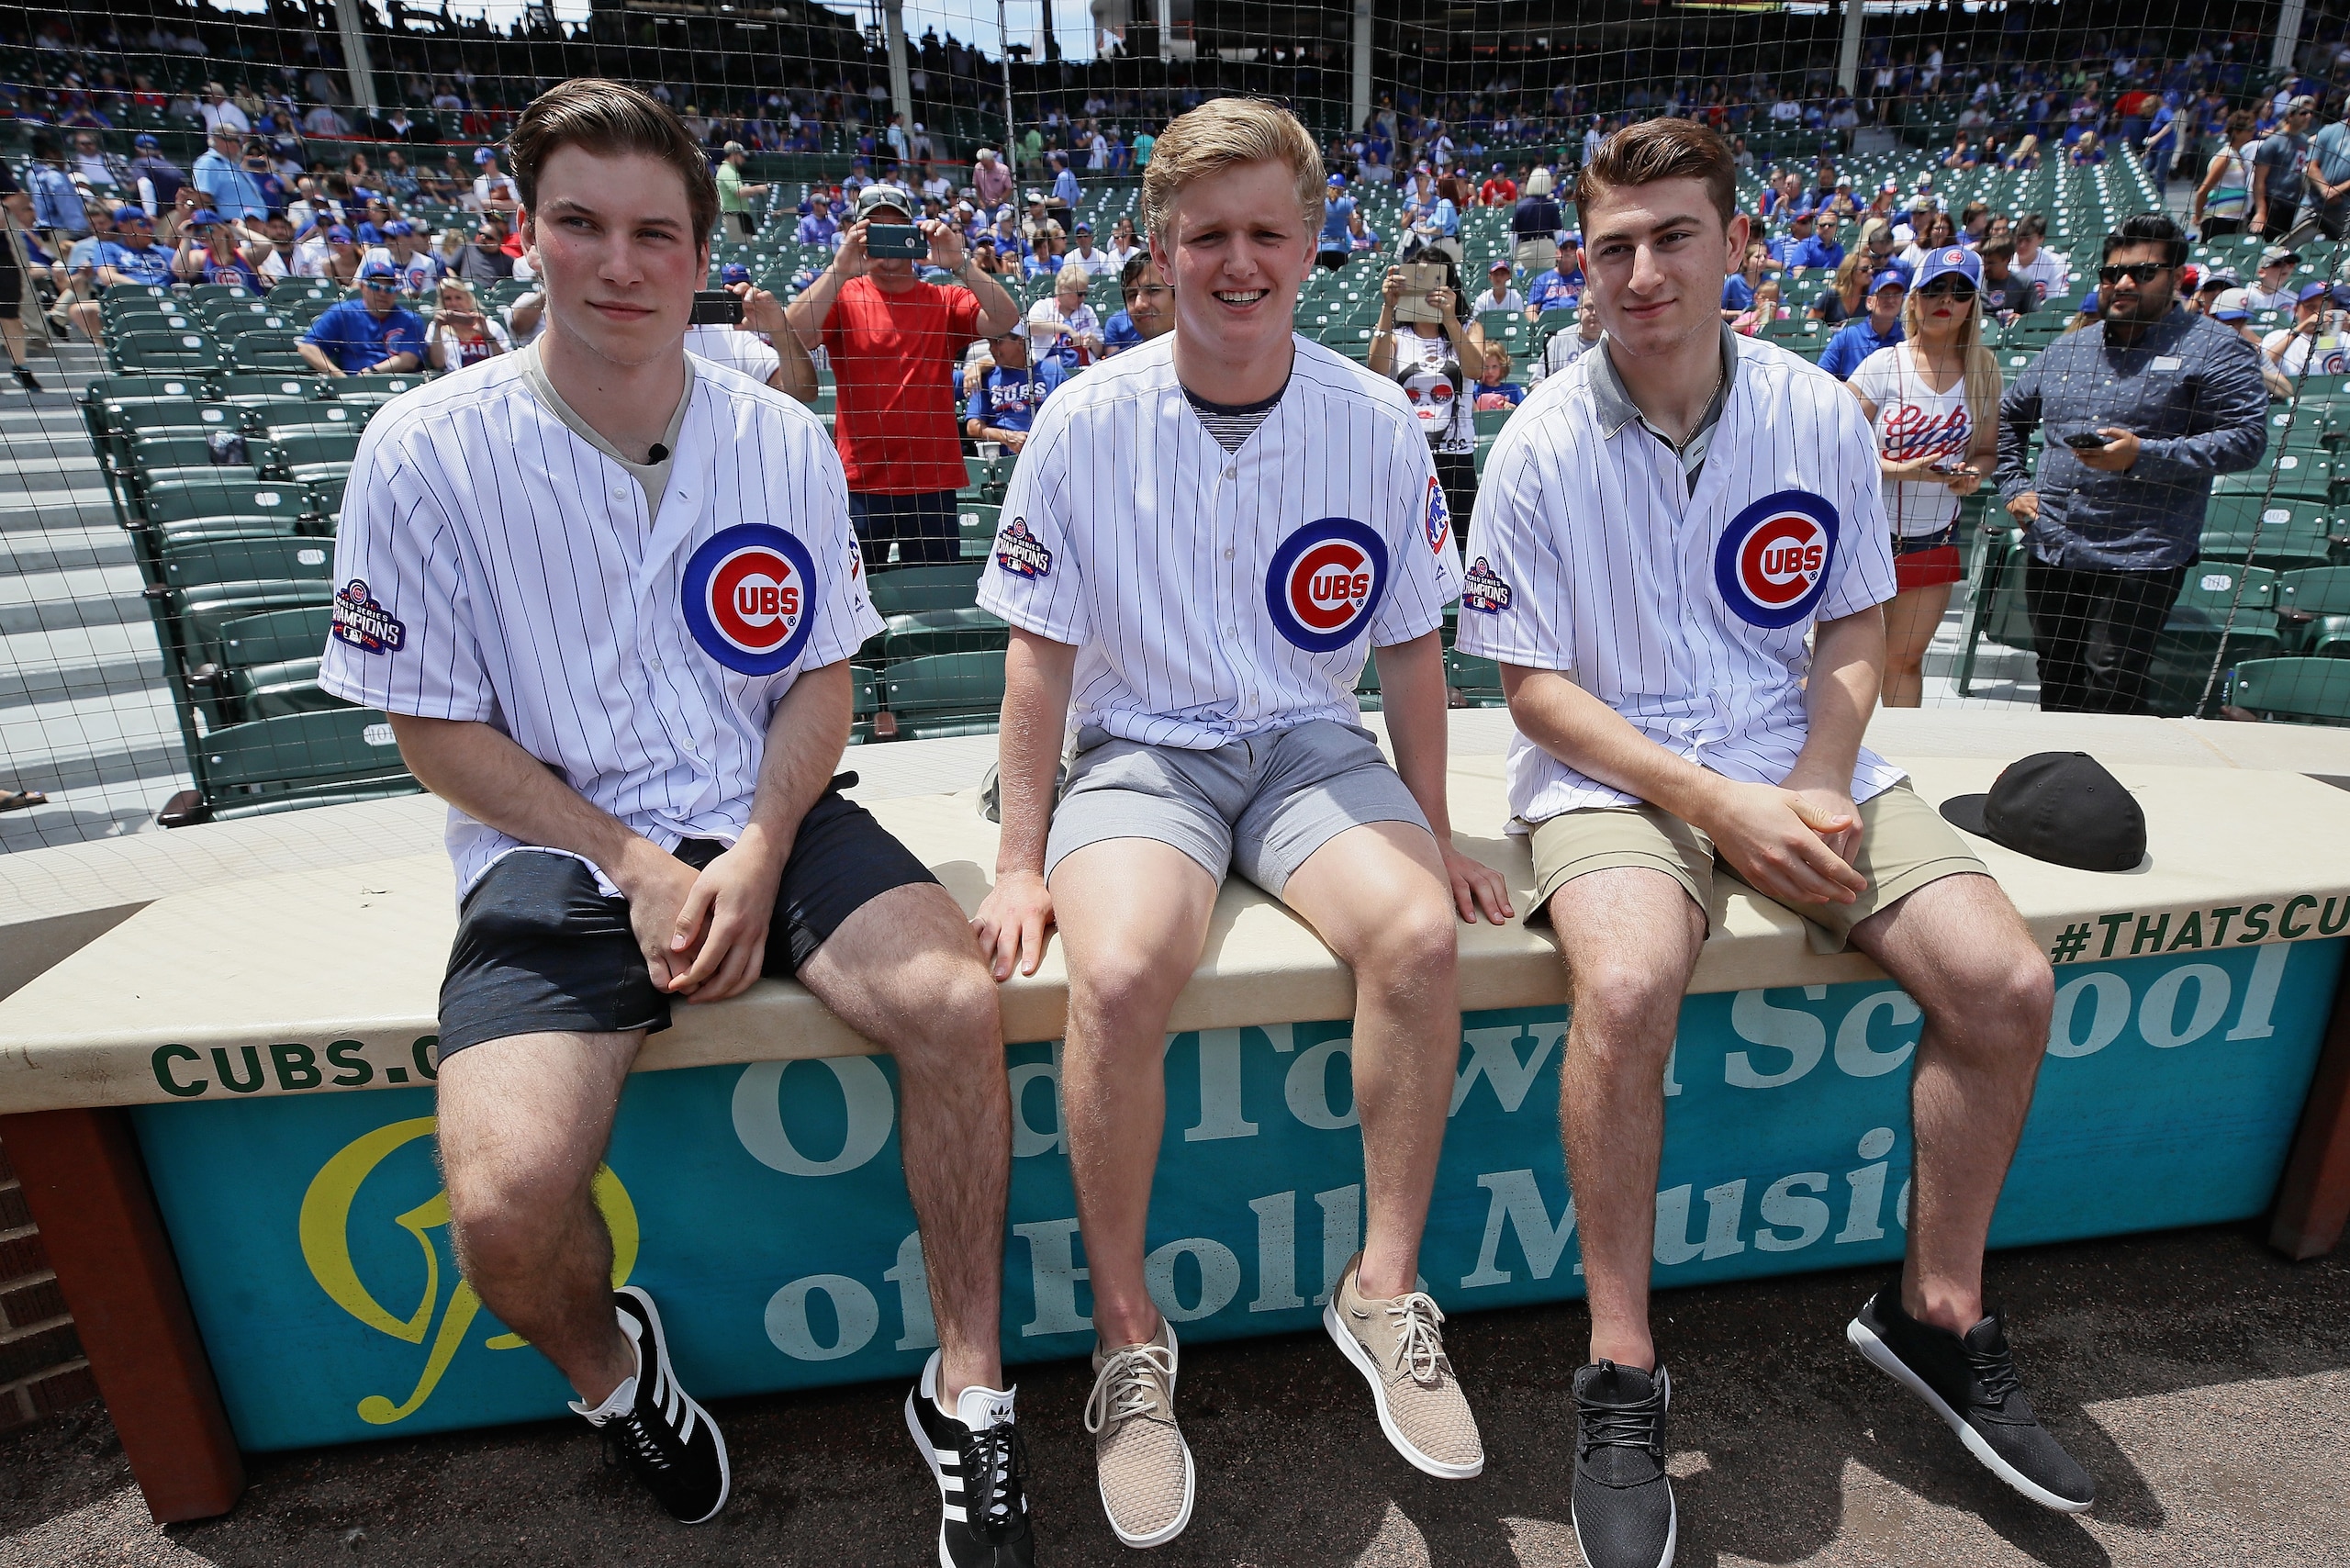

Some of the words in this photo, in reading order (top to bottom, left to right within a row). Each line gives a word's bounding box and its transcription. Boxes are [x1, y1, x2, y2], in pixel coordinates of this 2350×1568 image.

[1884, 405, 1967, 437] Cub
[998, 537, 1048, 572] CHAMPIONS
[356, 606, 388, 622] SERIES
[371, 726, 394, 741] 101
[732, 1041, 1068, 1177] Od
[1164, 1021, 1682, 1142] Tow
[1725, 942, 2293, 1089] Scool
[1460, 1127, 1909, 1289] Musi
